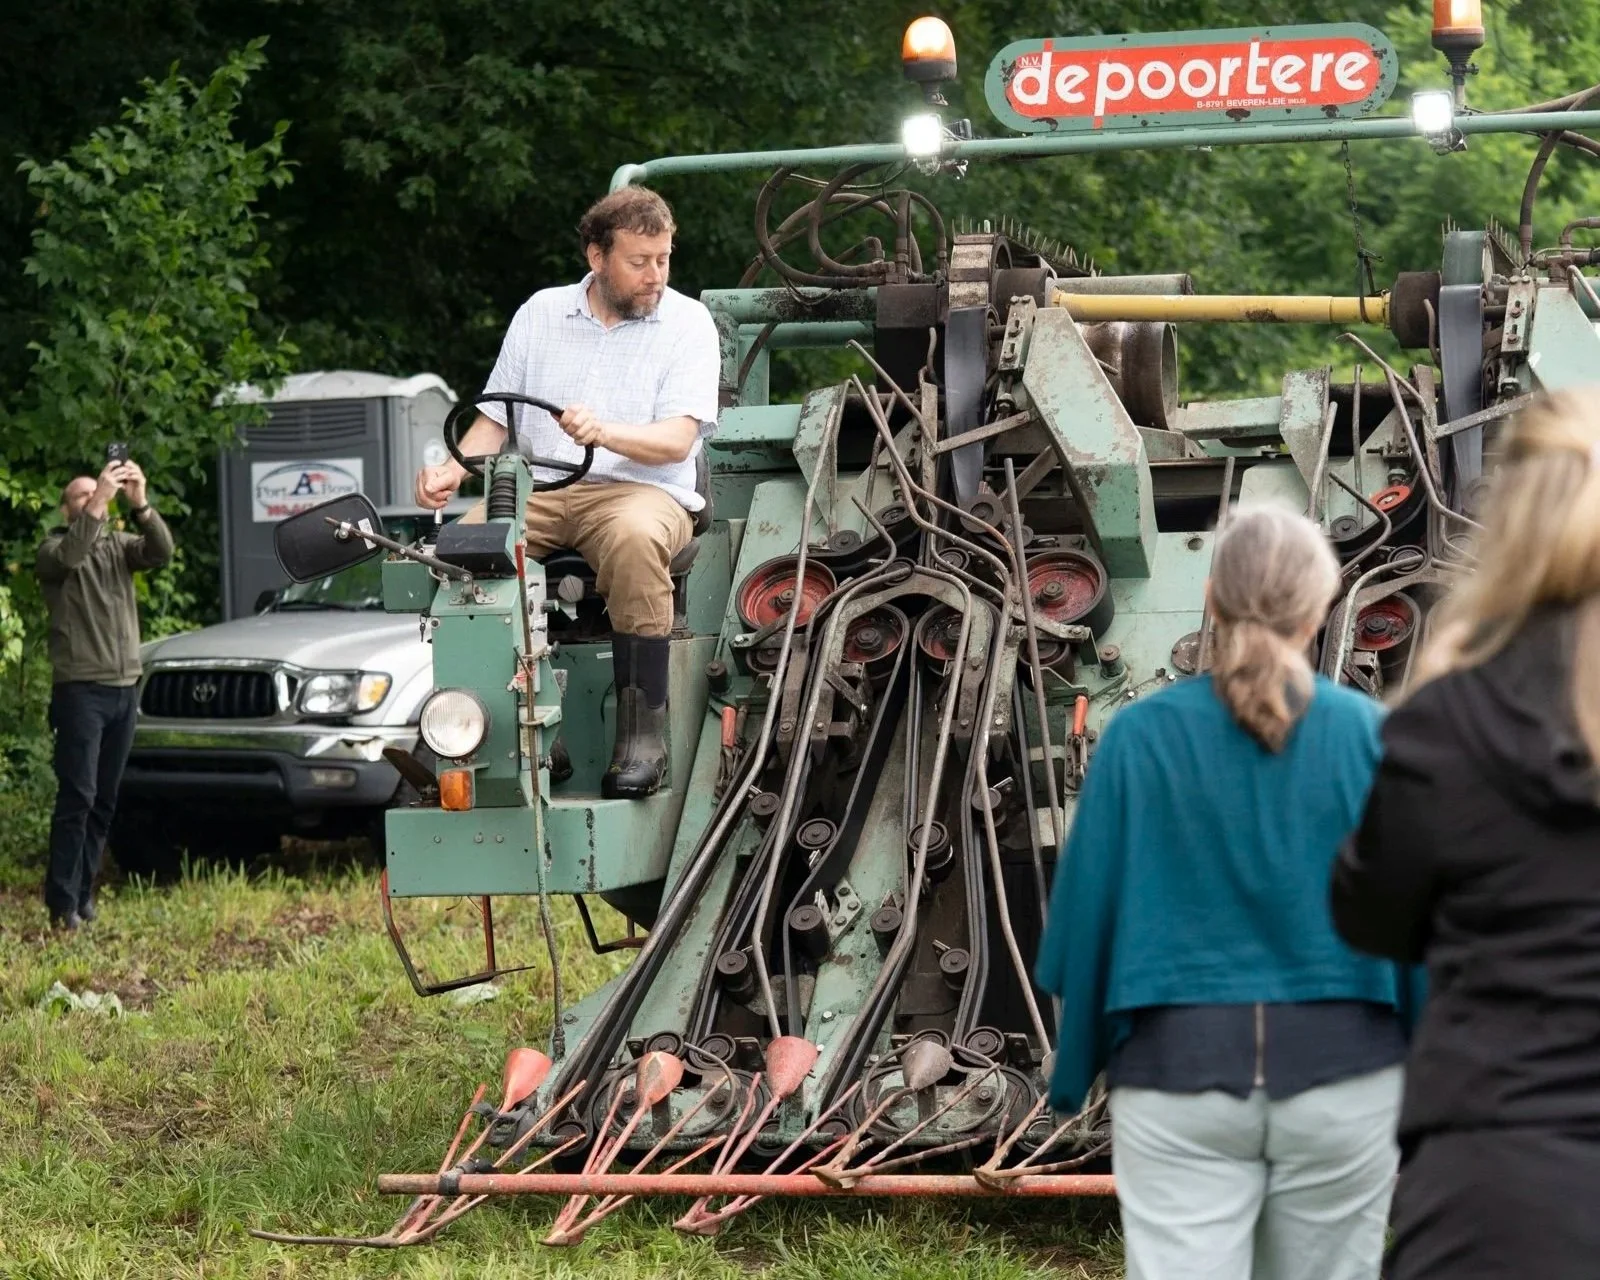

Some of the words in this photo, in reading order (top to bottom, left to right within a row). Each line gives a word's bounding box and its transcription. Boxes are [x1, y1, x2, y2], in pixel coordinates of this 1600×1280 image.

[1021, 56, 1040, 66] N.V.
[1012, 41, 1370, 116] depoortere
[1196, 100, 1224, 109] B-8791
[1226, 97, 1286, 107] BEVEREN-LEIE
[290, 472, 316, 495] A
